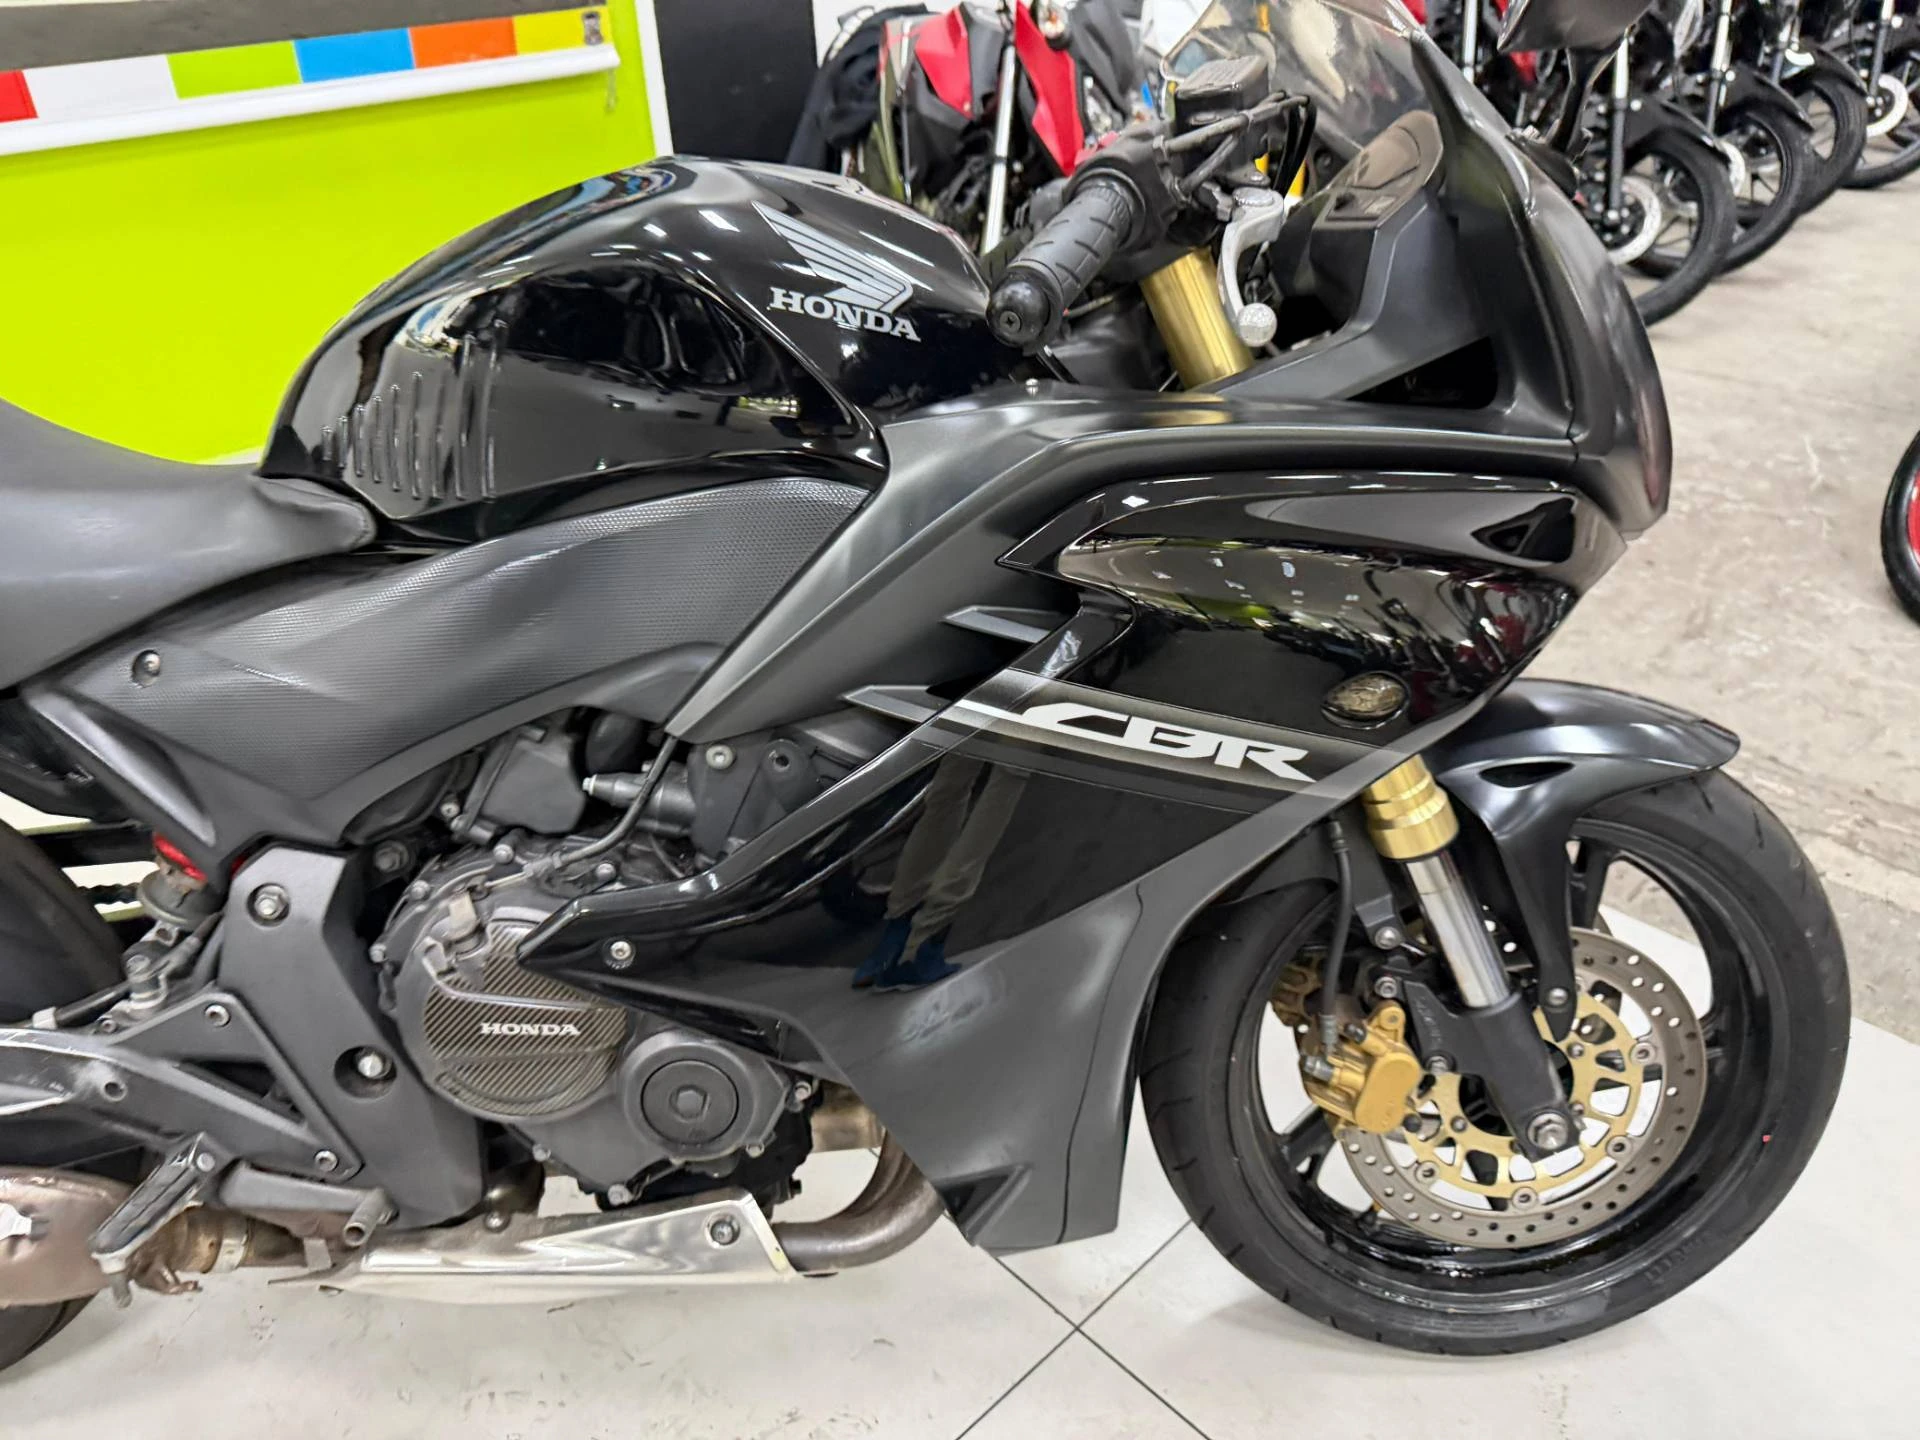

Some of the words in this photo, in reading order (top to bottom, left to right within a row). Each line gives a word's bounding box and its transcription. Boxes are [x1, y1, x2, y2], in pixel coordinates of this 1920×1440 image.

[768, 286, 921, 342] HONDA
[957, 699, 1316, 783] CBR
[480, 1022, 581, 1036] HONDA
